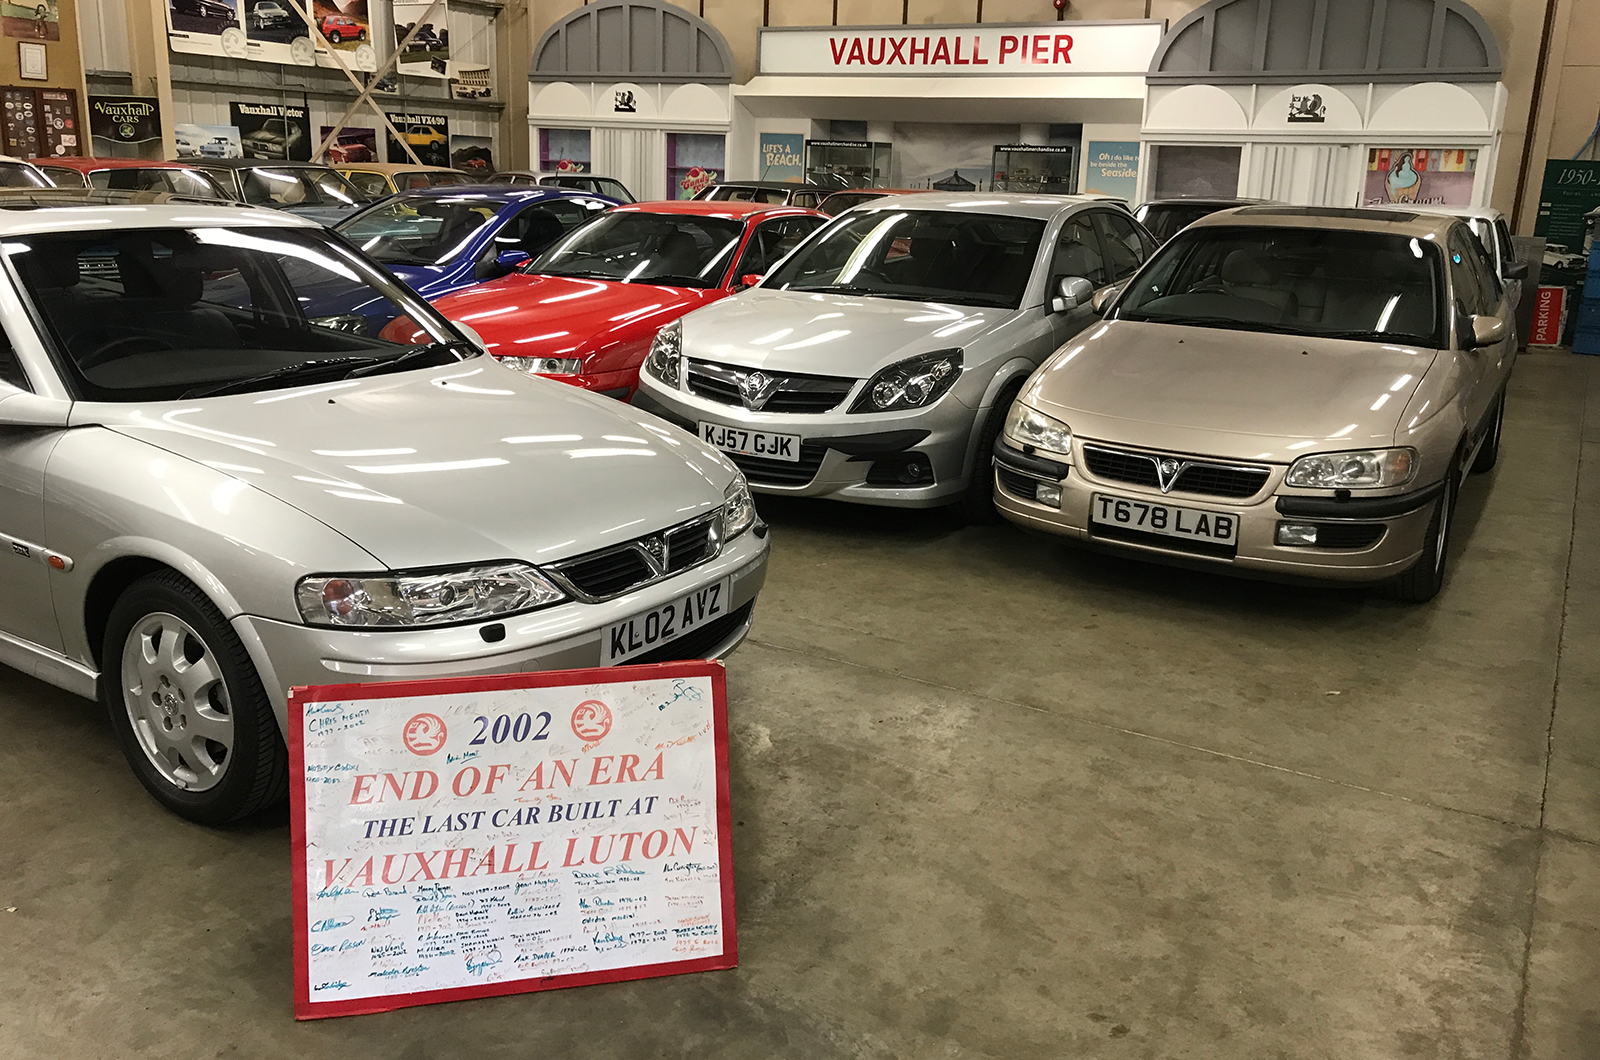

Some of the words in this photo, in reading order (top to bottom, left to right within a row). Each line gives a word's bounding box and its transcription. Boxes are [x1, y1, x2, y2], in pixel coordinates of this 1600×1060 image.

[829, 36, 988, 66] VAUXHALL
[998, 34, 1074, 65] PIER
[95, 102, 154, 116] Vauxhall
[112, 115, 139, 123] CARS
[238, 104, 278, 116] Vauxhall
[763, 143, 783, 153] LIFE'S
[784, 144, 791, 154] A
[1098, 153, 1111, 161] Oh
[1122, 154, 1134, 162] like
[681, 171, 710, 192] Candy
[1101, 167, 1137, 178] Seaside
[1557, 168, 1600, 186] 1950-
[1536, 291, 1552, 341] PARKING
[705, 425, 749, 450] KJ57
[754, 434, 792, 457] GJK
[1098, 497, 1168, 529] T678
[1175, 510, 1233, 539] LAB
[611, 605, 675, 659] KL02
[682, 583, 721, 629] AVZ
[468, 711, 551, 746] 2002
[349, 769, 439, 806] END
[452, 763, 511, 798] OF
[517, 758, 580, 792] AN
[586, 751, 665, 786] ERA
[363, 816, 416, 840] THE
[421, 810, 486, 835] LAST
[491, 805, 541, 828] CAR
[547, 799, 622, 824] BUILT
[625, 796, 659, 817] AT
[323, 841, 549, 889] VAUXHALL
[560, 826, 699, 869] LUTON
